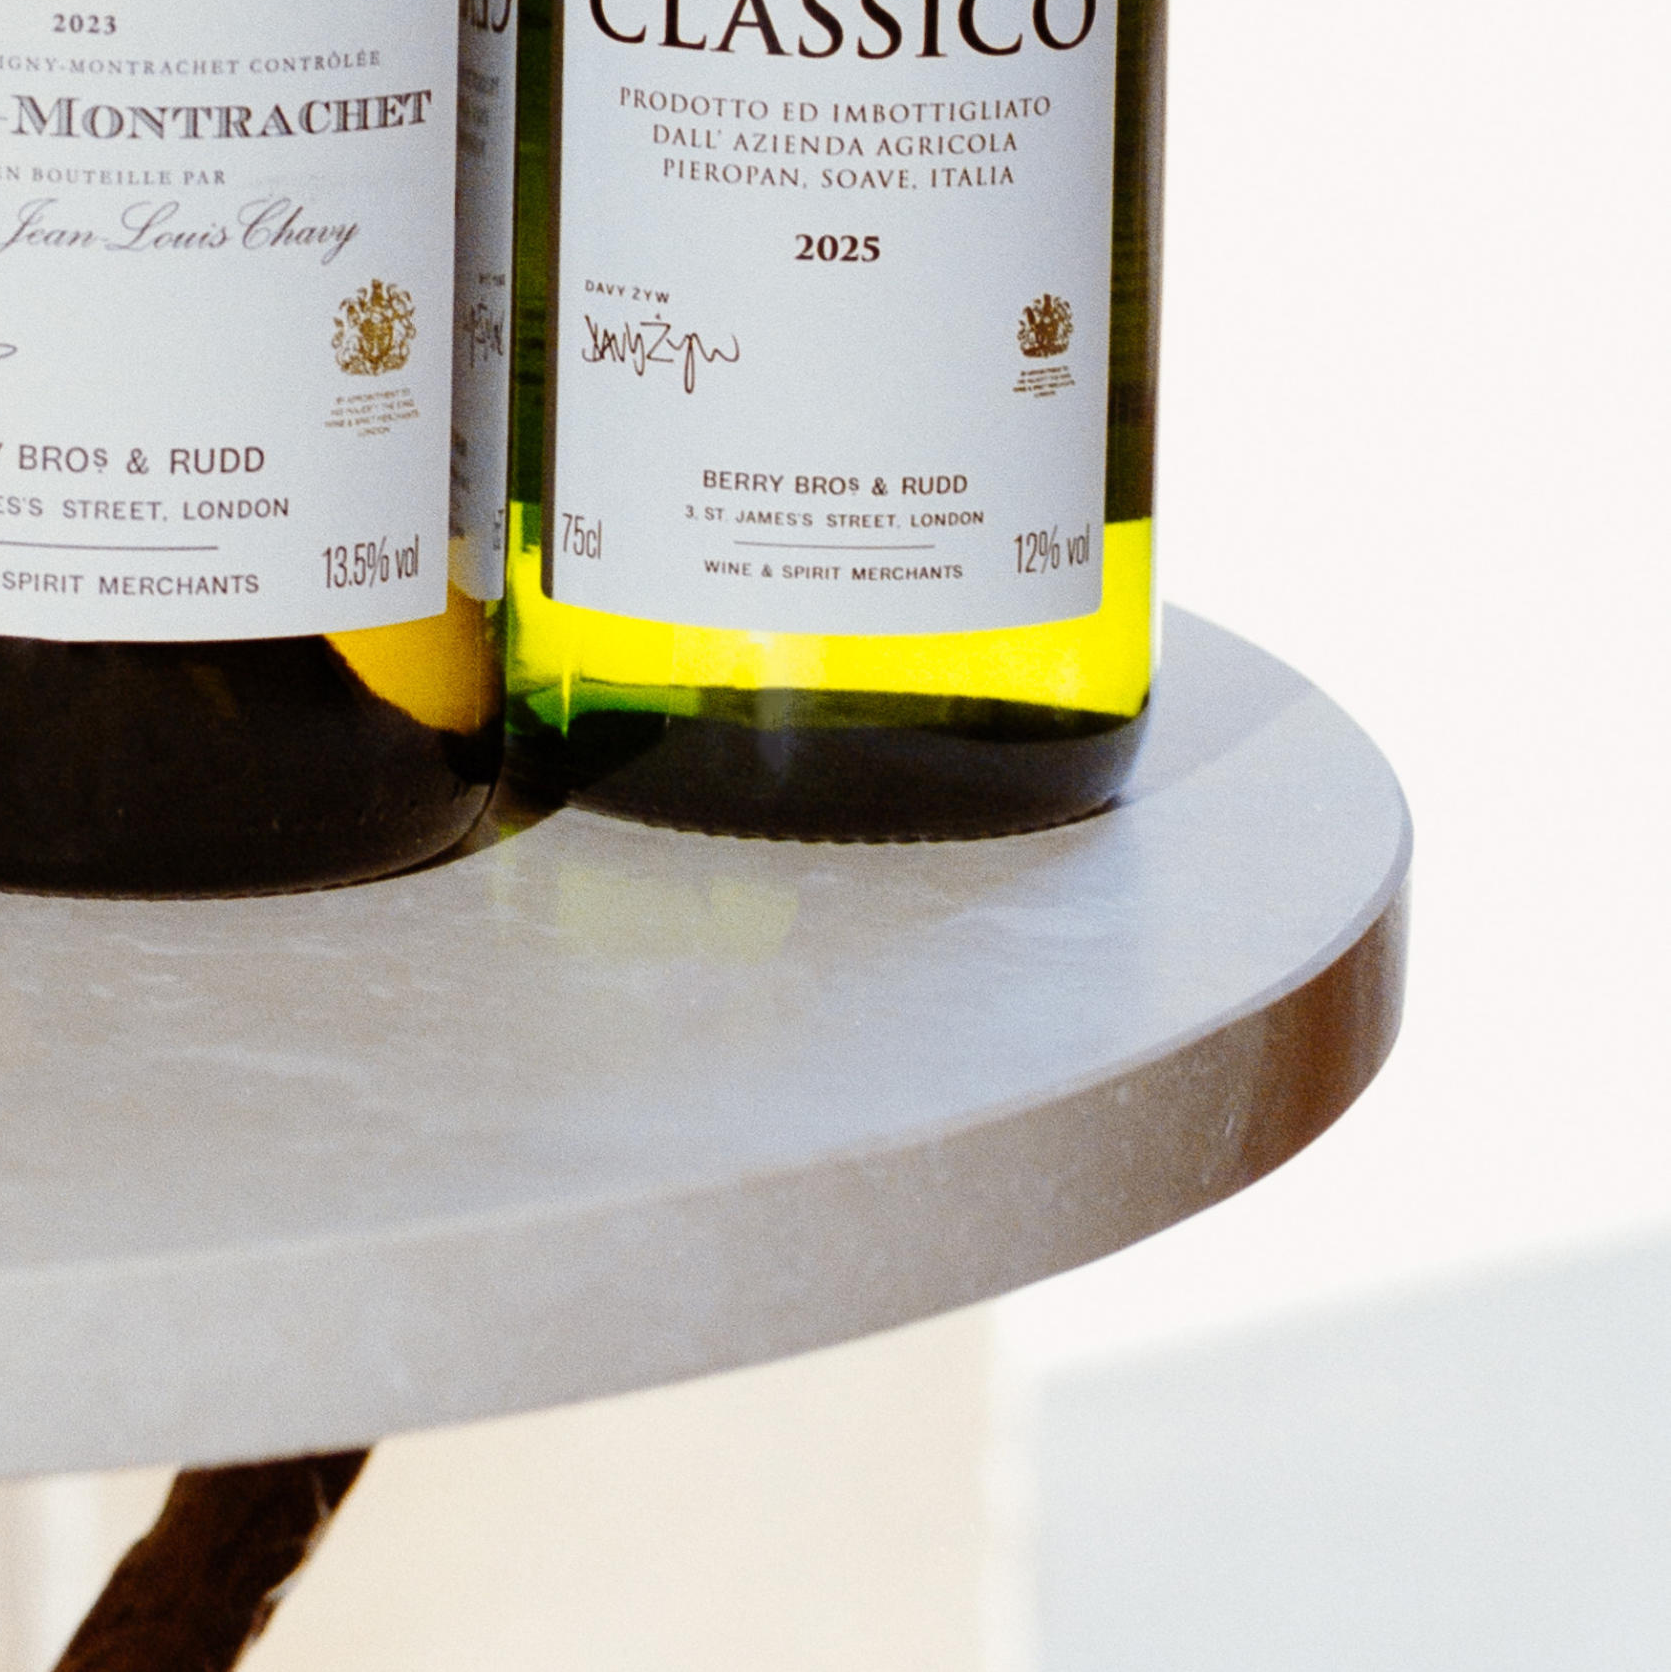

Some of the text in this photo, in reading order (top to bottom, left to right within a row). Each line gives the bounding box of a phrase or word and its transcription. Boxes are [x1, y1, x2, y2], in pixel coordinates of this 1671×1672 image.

[52, 12, 118, 36] 2023
[248, 48, 381, 75] CONTRÔLÉE
[619, 85, 1052, 125] PRODOTTO ED IMBOTTIGLIATO
[732, 132, 865, 157] AZIENDA
[875, 132, 1018, 157] AGRICOLA
[31, 166, 172, 187] BOUTEILLE
[182, 168, 226, 186] PAR
[930, 165, 1015, 189] ITALIA
[237, 196, 360, 266] Chavy
[794, 233, 881, 263] 2025
[584, 278, 626, 298] DAVY
[125, 446, 150, 476] &
[169, 445, 266, 476] RUDD
[702, 468, 785, 494] BERRY
[870, 476, 889, 497] &
[900, 473, 969, 496] RUDD
[182, 496, 290, 522] LONDON
[734, 509, 814, 528] JAMES'S
[909, 510, 985, 529] LONDON
[562, 512, 603, 561] 75cl
[1013, 522, 1091, 575] 12% vol
[321, 533, 420, 590] 13.5% vol
[703, 559, 964, 582] WINE & SPIRIT MERCHANTS
[1, 569, 85, 595] SPIRIT
[98, 573, 261, 597] MERCHANTS
